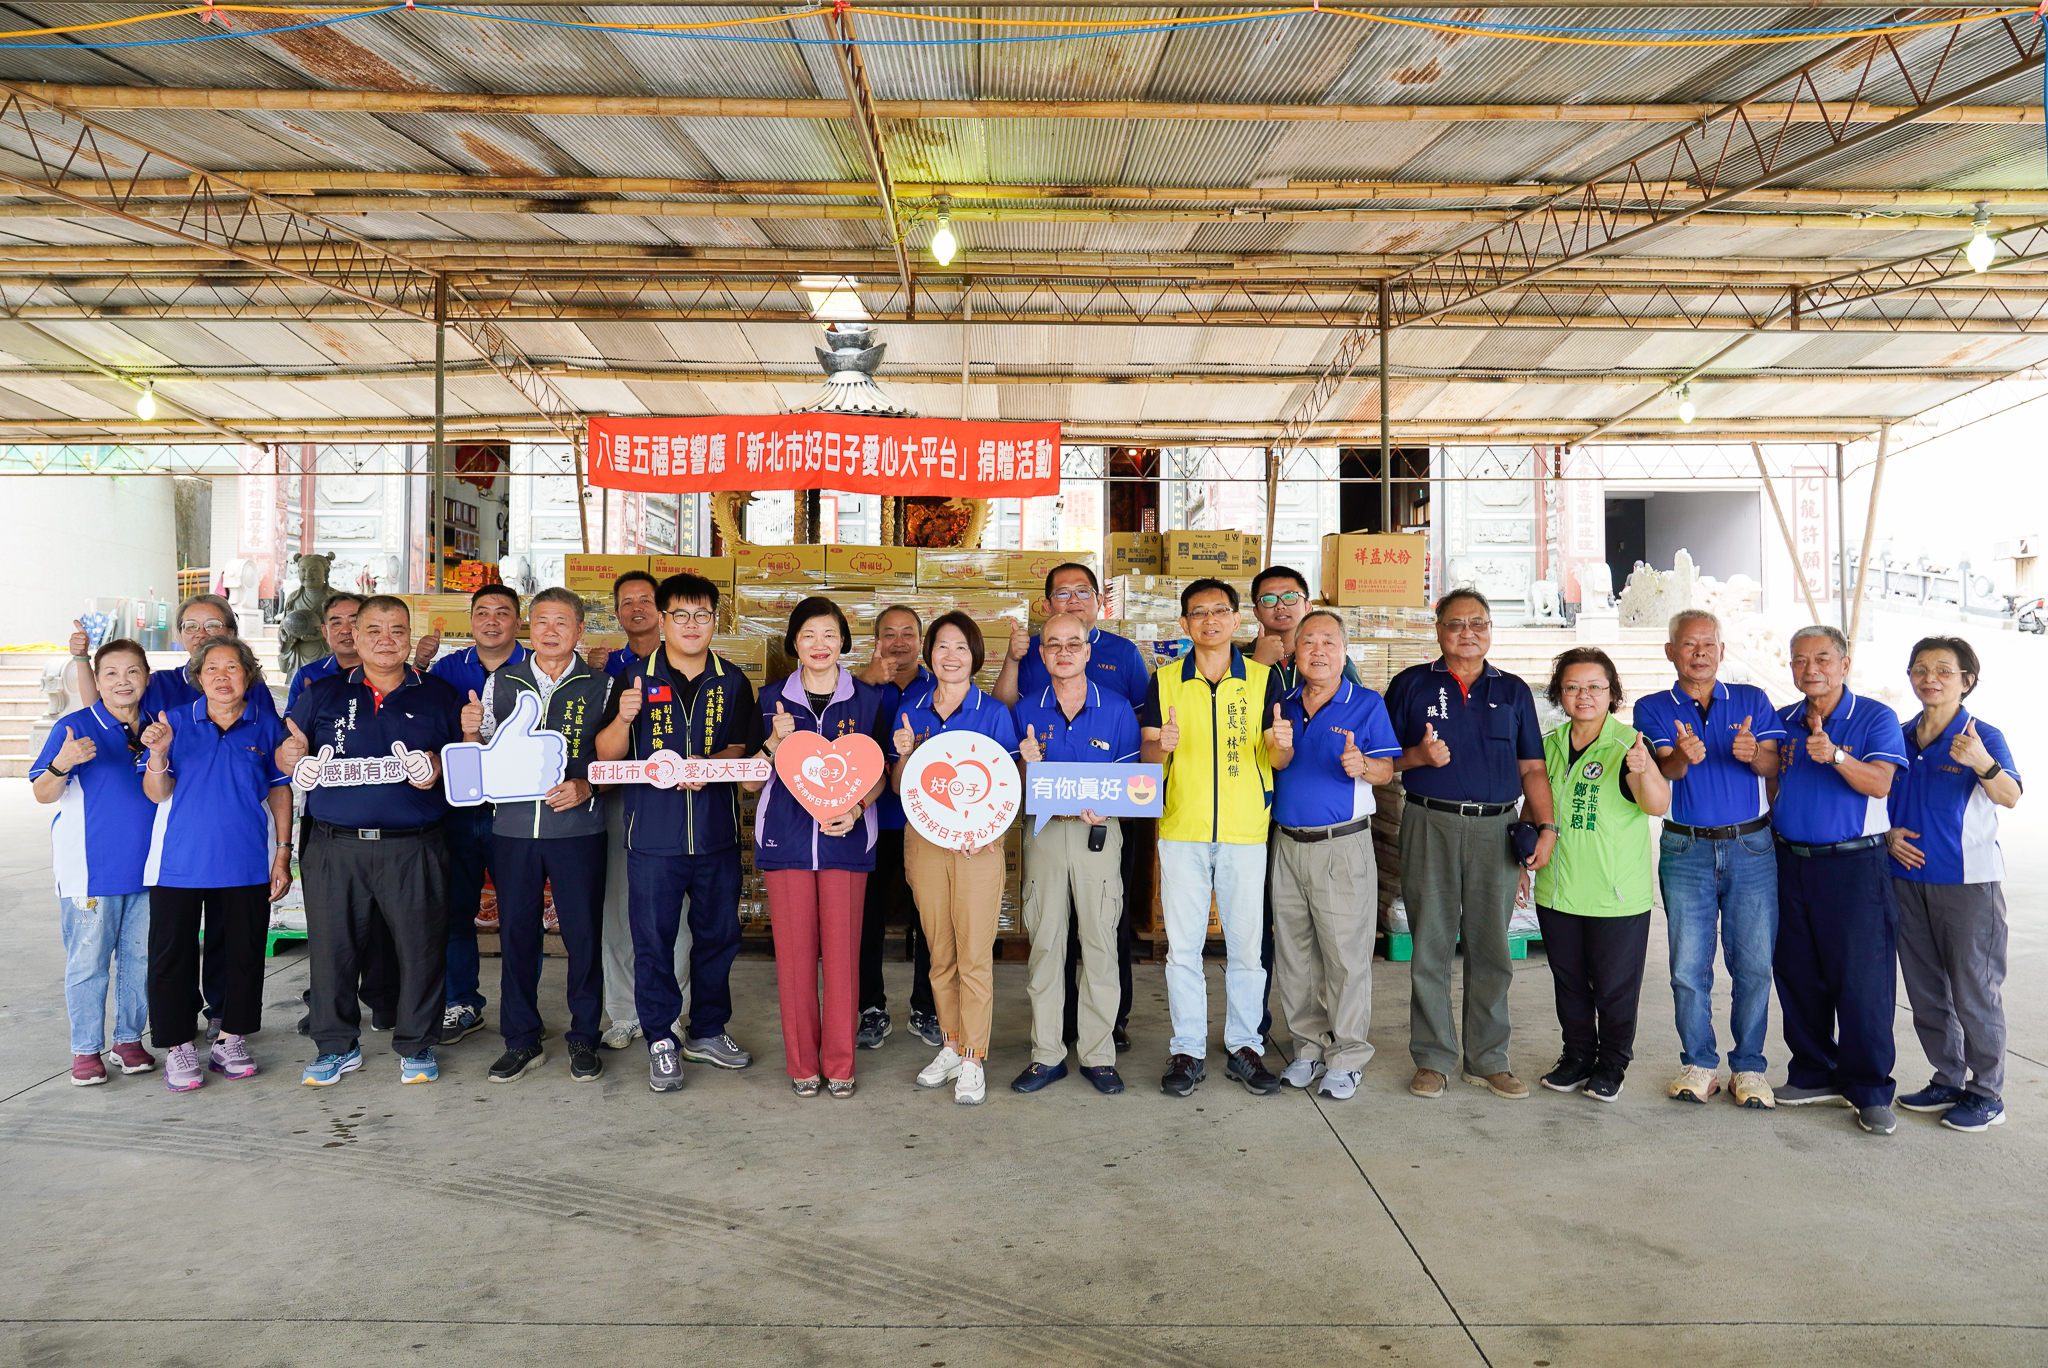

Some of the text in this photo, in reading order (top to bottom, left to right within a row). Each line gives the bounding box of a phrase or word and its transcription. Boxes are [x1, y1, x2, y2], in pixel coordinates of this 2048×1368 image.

[1354, 547, 1412, 566] 祥益炊粉
[563, 700, 575, 720] 里長
[575, 696, 587, 725] 八里區
[663, 704, 674, 734] 副主任
[716, 685, 724, 723] 立法委員
[1227, 703, 1238, 729] 區長
[334, 717, 346, 754] 洪志成
[1239, 697, 1248, 745] 八里區公所
[324, 761, 402, 782] 感謝有您
[591, 764, 641, 781] 新北市
[684, 762, 770, 780] 愛心大平台
[793, 773, 863, 808] 新北市好日子愛心大平台
[1570, 781, 1588, 829] 鄭宇恩
[907, 787, 1015, 843] 新北市好日子愛心大平台
[1585, 783, 1601, 832] 新北市議員
